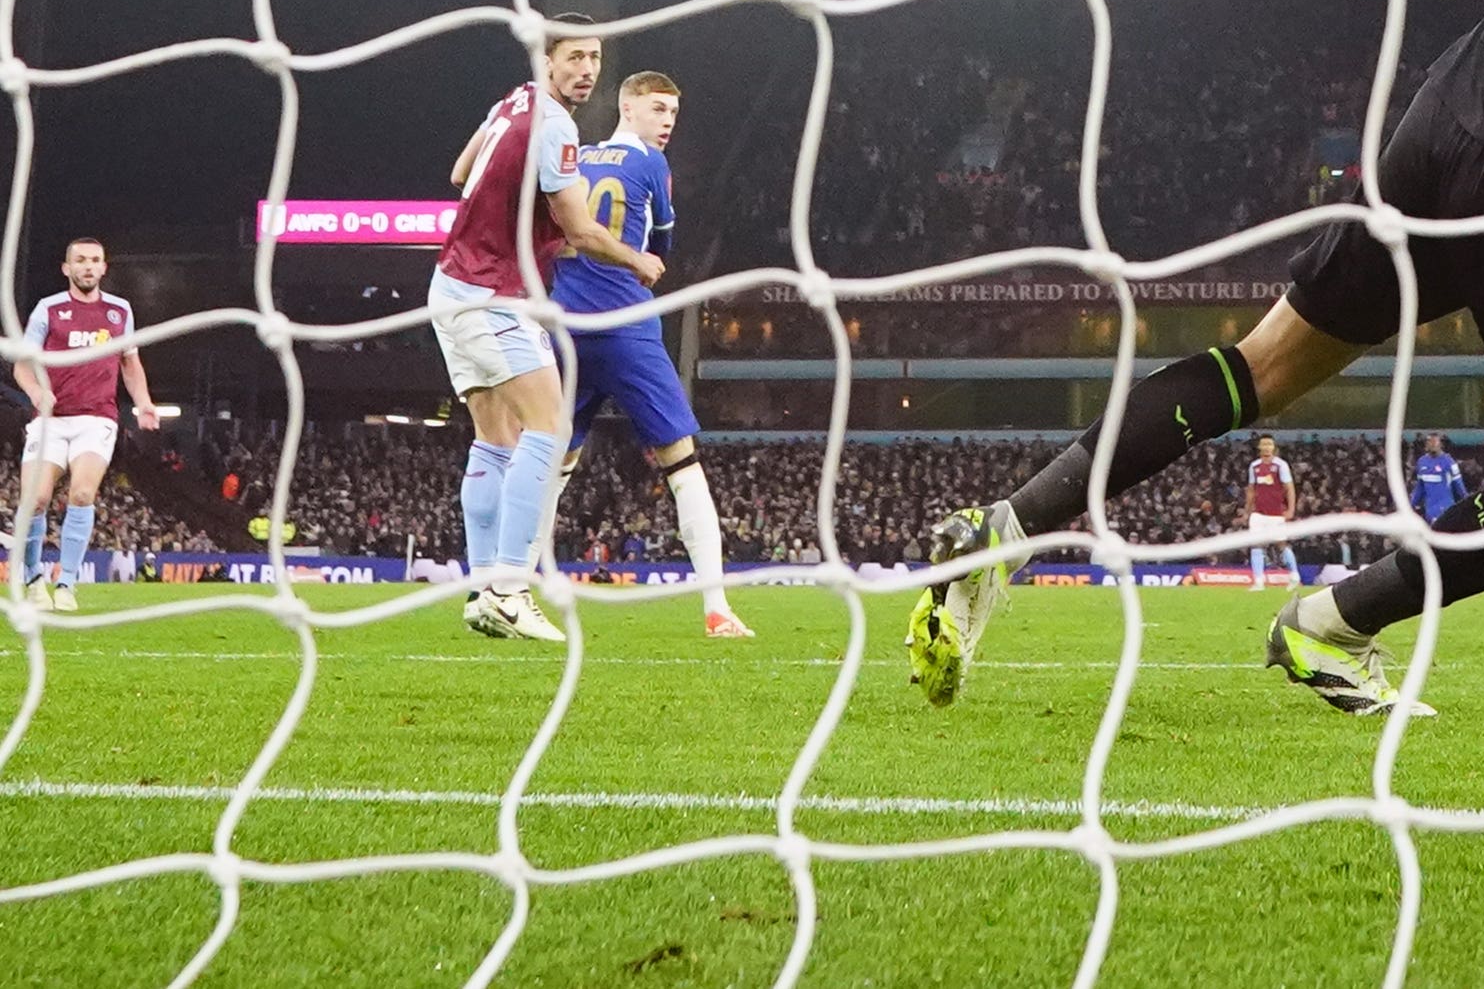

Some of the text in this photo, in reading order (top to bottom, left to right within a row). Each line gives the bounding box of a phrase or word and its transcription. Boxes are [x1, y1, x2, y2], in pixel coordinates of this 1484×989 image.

[580, 148, 628, 166] PALMER
[287, 212, 437, 233] AVFC 0-0 CHE
[950, 283, 1063, 302] PREPARED
[1070, 283, 1101, 300] TO
[1251, 281, 1295, 299] DO
